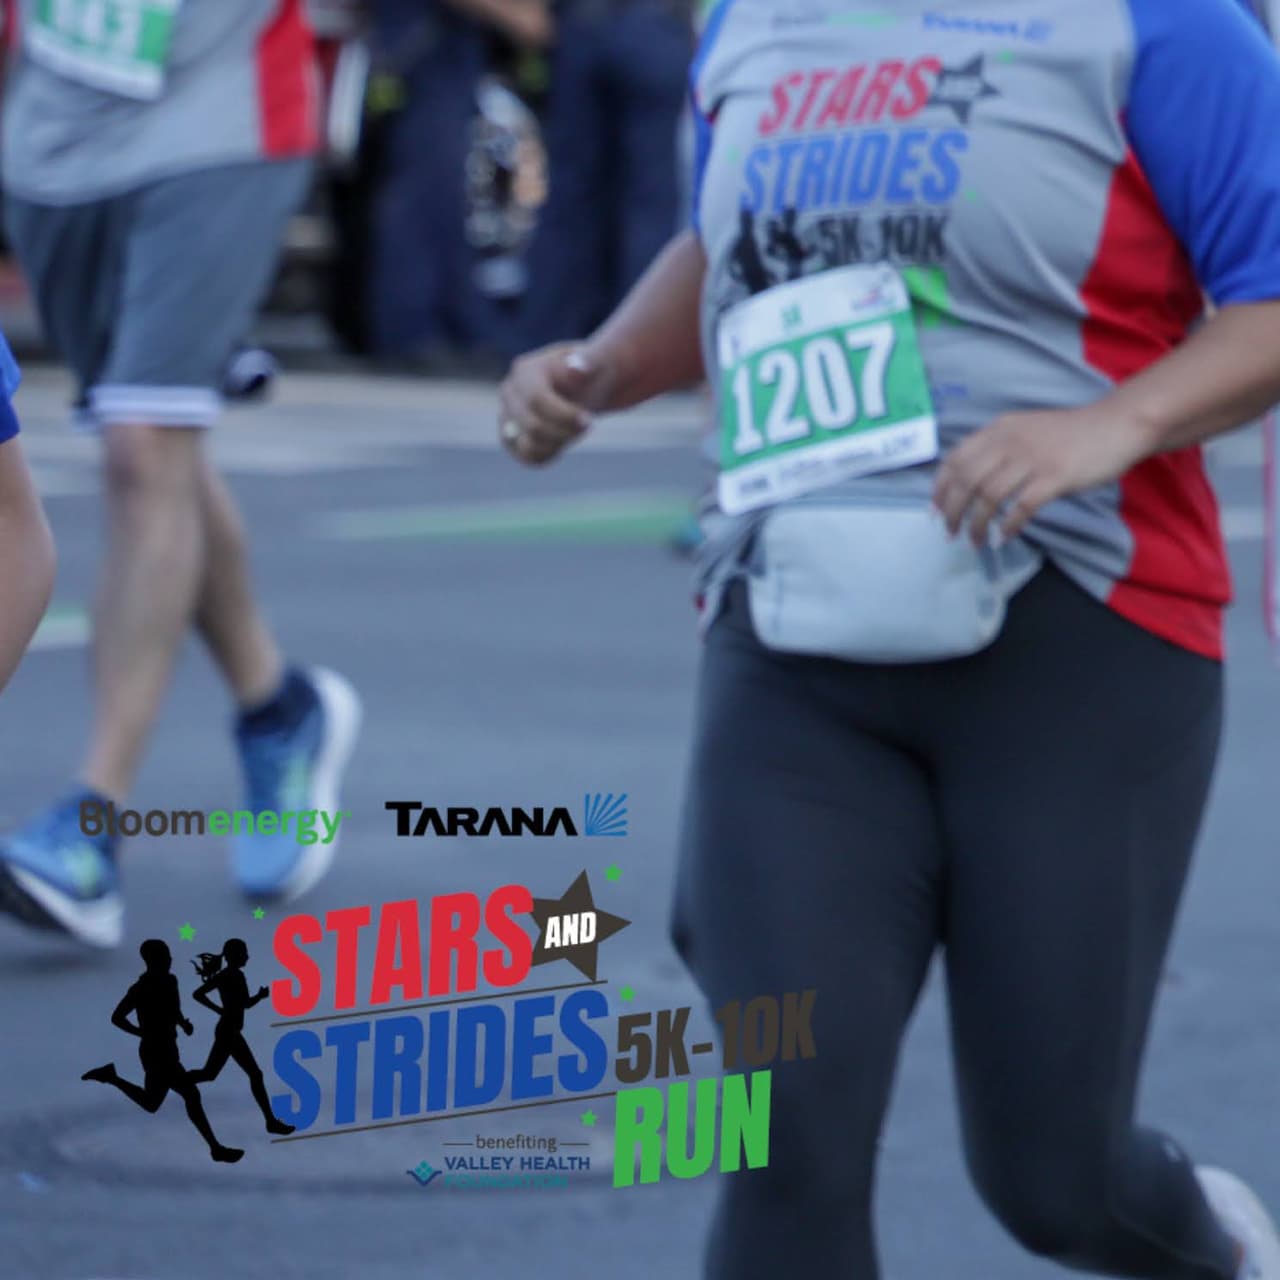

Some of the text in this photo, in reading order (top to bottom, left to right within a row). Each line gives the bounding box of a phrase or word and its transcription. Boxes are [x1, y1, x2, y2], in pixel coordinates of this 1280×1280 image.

[757, 55, 944, 137] STARS
[740, 127, 969, 217] STRIDES
[731, 321, 895, 455] 1207
